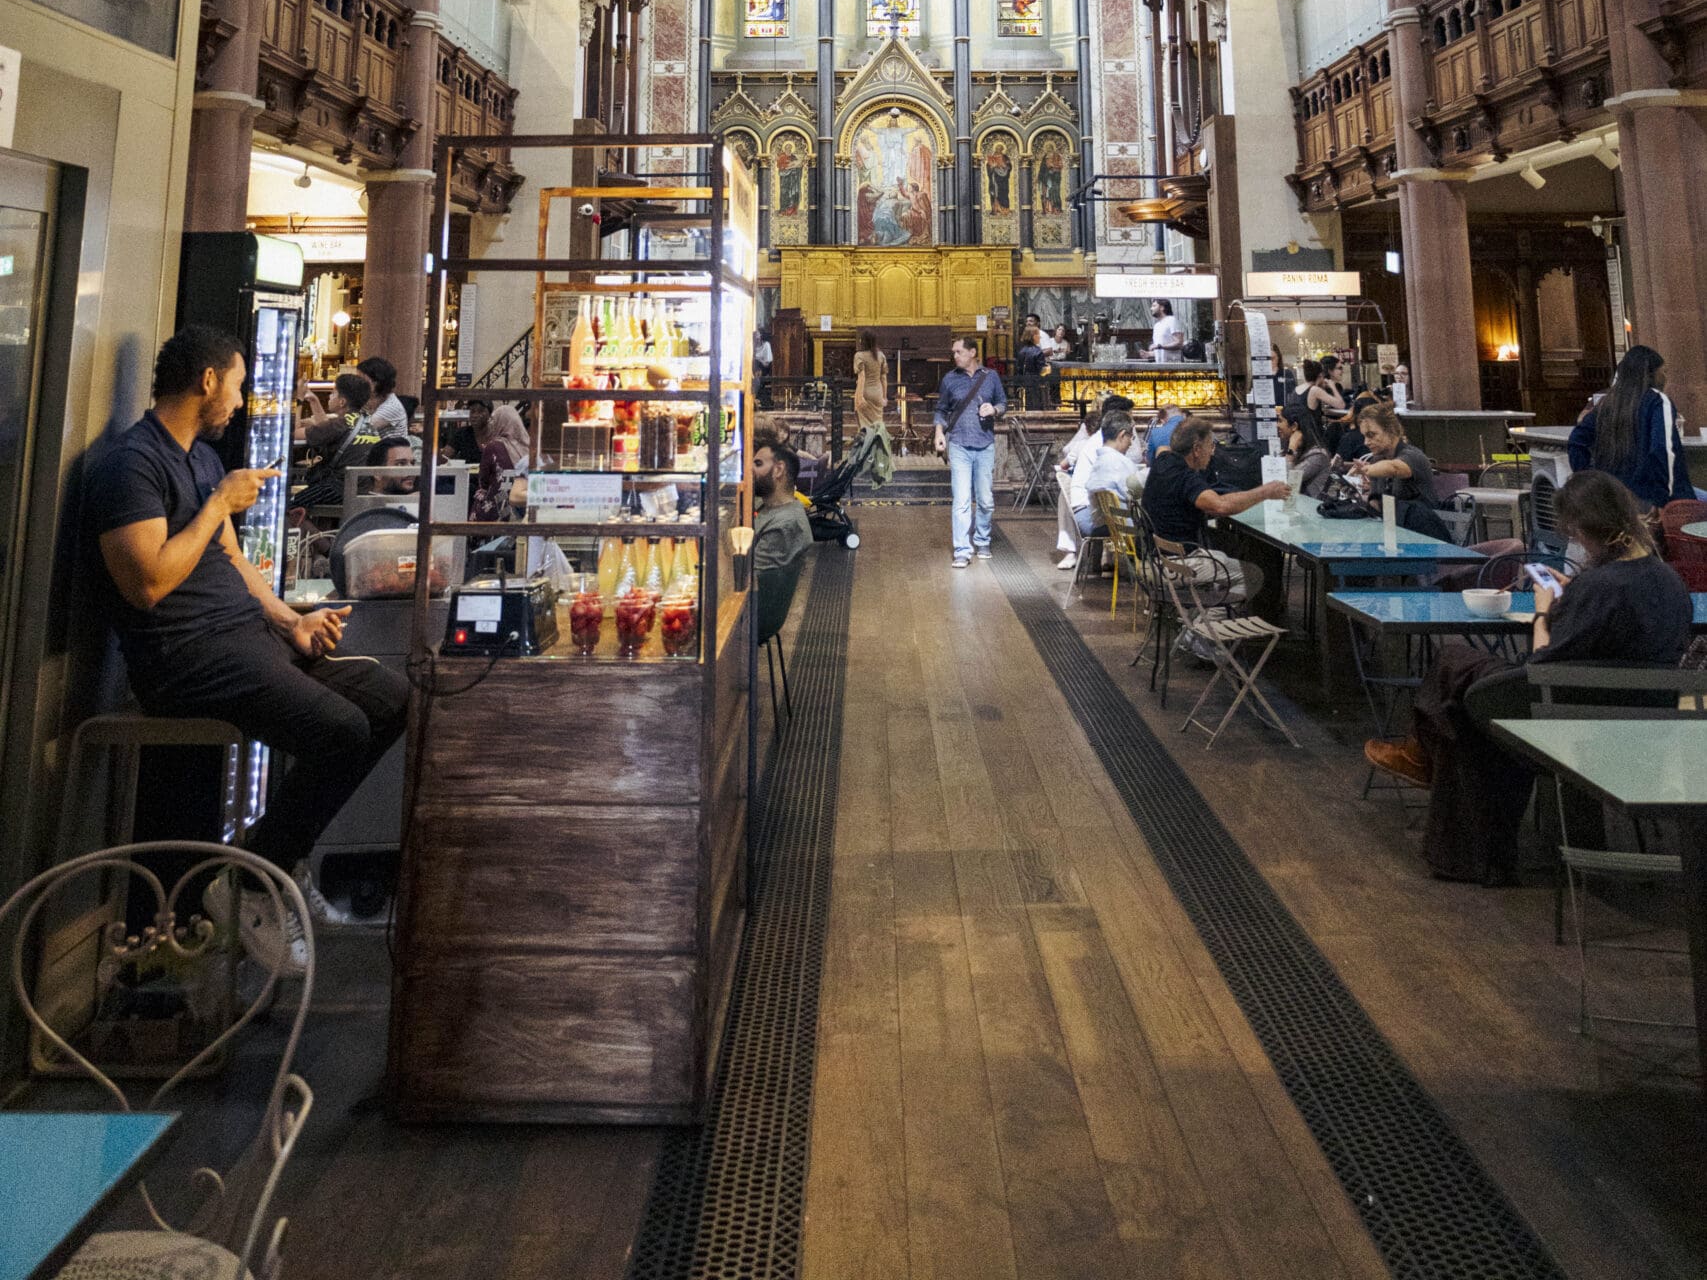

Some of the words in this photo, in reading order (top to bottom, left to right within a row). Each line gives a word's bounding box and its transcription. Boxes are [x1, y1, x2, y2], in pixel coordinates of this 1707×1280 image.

[1125, 278, 1148, 289] FRESH
[1150, 278, 1168, 289] BEER
[1170, 278, 1185, 289] BAR
